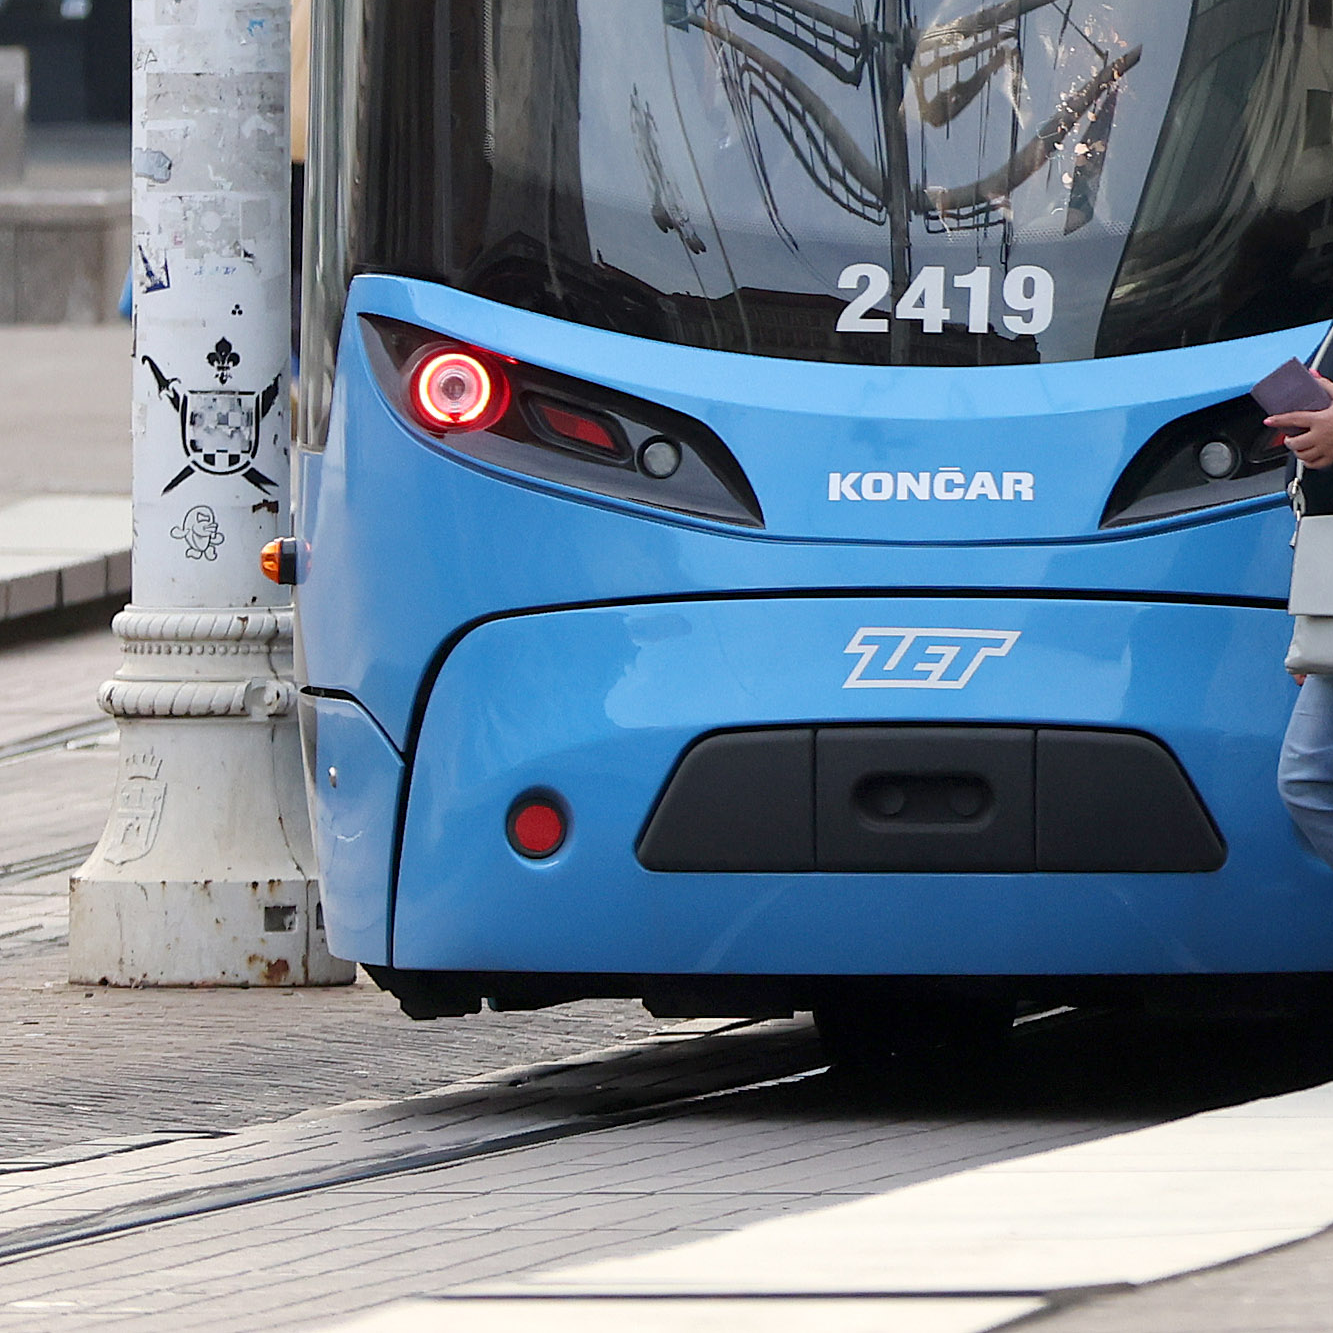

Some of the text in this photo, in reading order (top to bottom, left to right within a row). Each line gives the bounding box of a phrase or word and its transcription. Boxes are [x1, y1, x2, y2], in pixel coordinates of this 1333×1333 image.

[835, 263, 1056, 336] 2419
[827, 466, 1035, 502] KONČAR
[841, 626, 1023, 691] ZET
